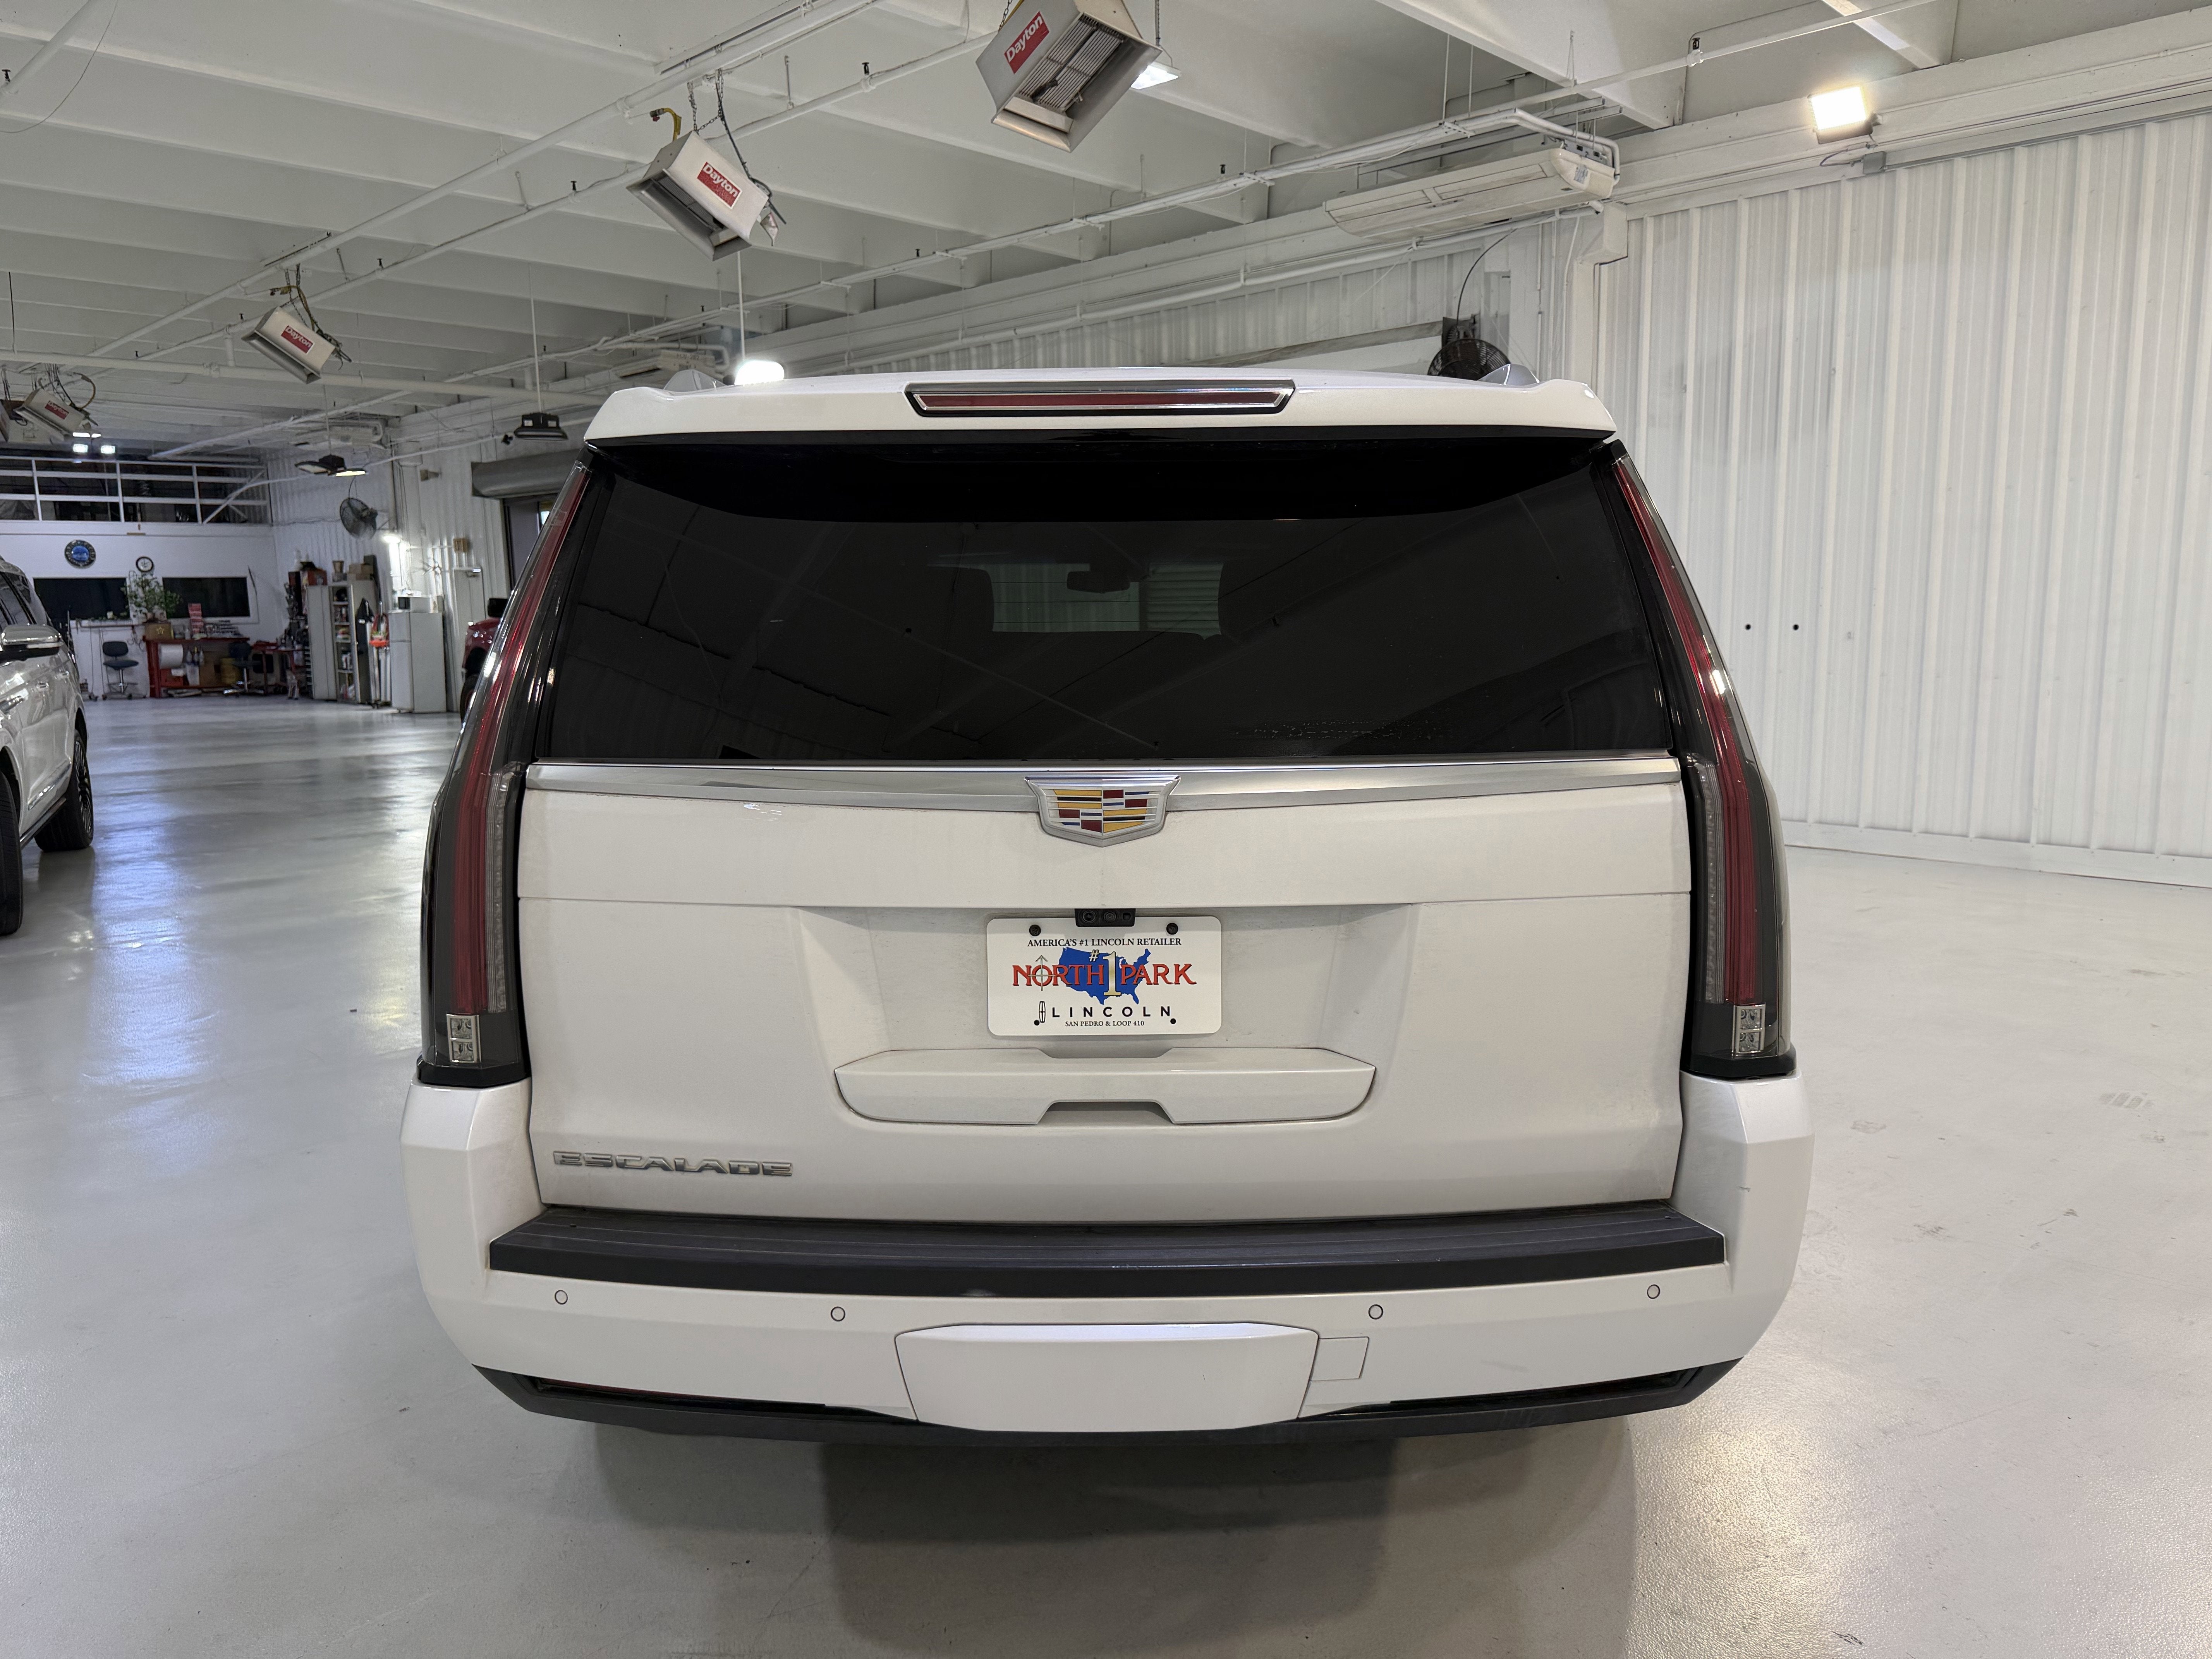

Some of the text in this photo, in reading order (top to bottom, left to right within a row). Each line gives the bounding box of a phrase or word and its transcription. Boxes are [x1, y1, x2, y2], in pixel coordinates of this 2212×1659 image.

[1006, 16, 1043, 62] Dayton
[702, 164, 738, 197] Dayton
[285, 327, 312, 348] Dayton
[1027, 939, 1077, 947] AMERICA'S
[1012, 963, 1197, 986] NORTH PARK
[1052, 1006, 1170, 1018] LINCOLN
[553, 1151, 793, 1176] ESCALADE
